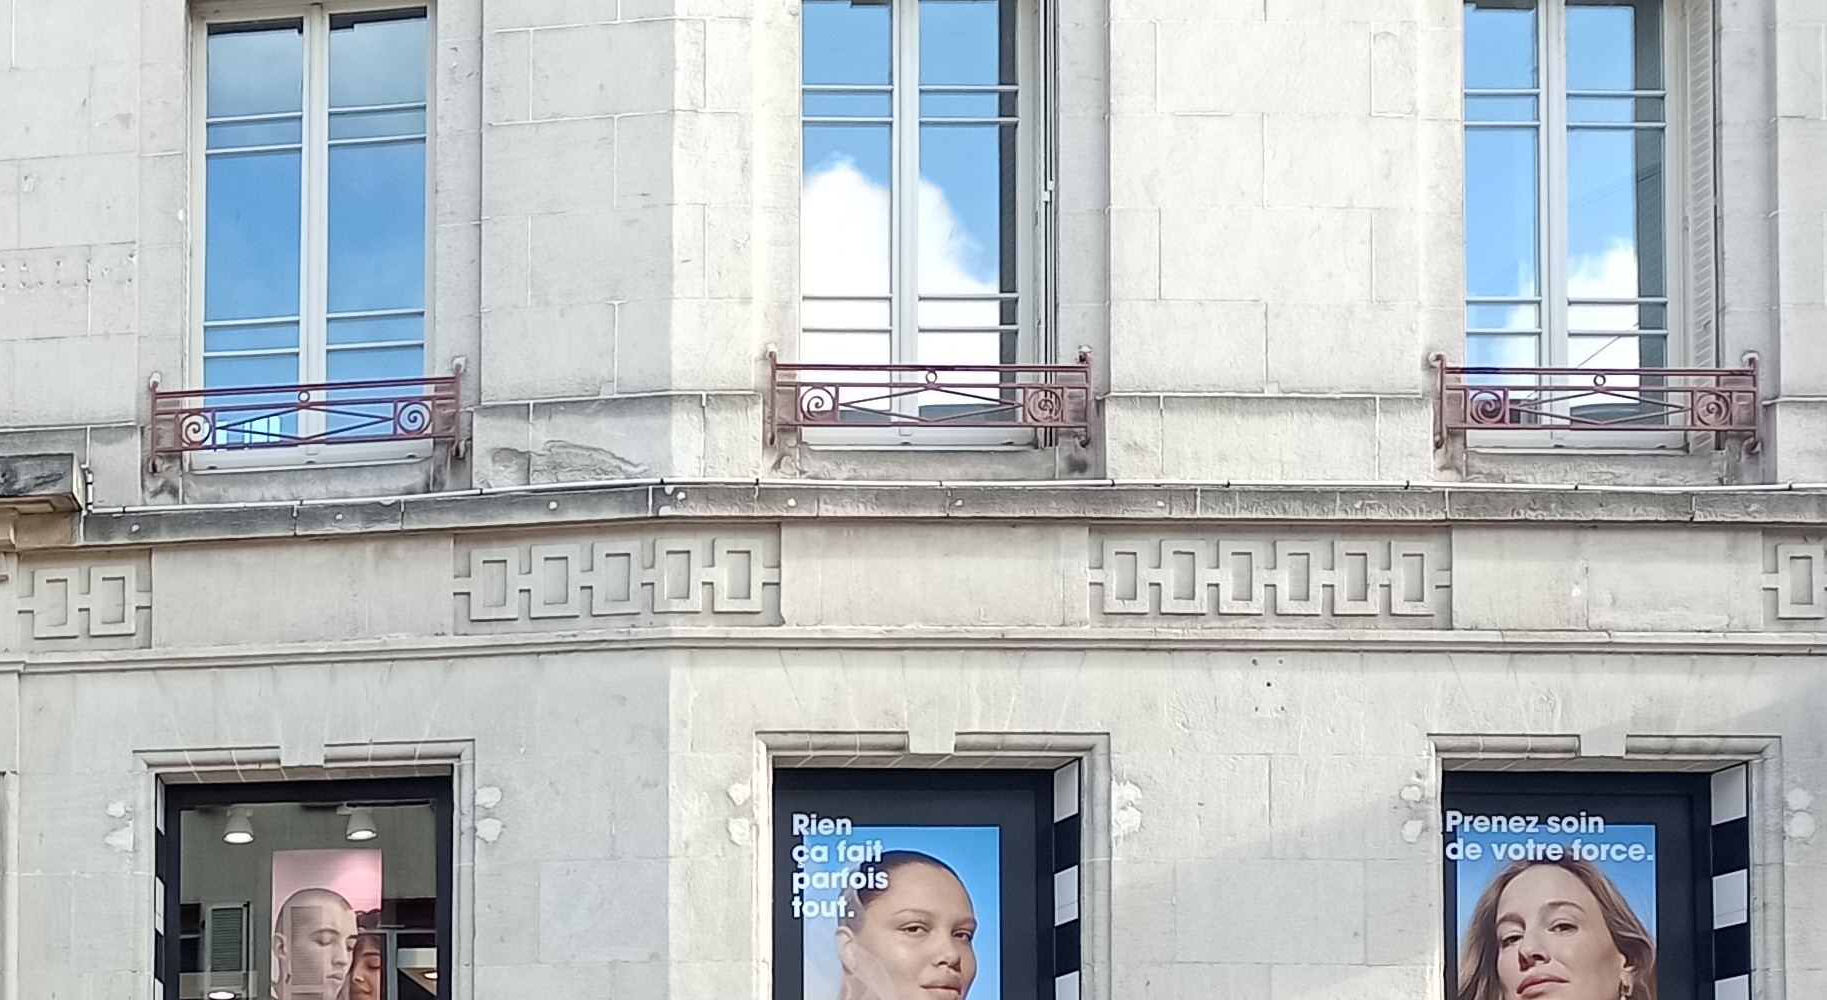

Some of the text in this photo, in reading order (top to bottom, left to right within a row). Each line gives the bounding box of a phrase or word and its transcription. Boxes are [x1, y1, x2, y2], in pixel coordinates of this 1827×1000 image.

[793, 813, 852, 835] Rien
[1446, 810, 1604, 834] Prenez soin
[792, 840, 883, 868] ça fait
[1446, 837, 1653, 861] de votre force.
[793, 867, 889, 893] parfois
[792, 895, 855, 918] tout.
